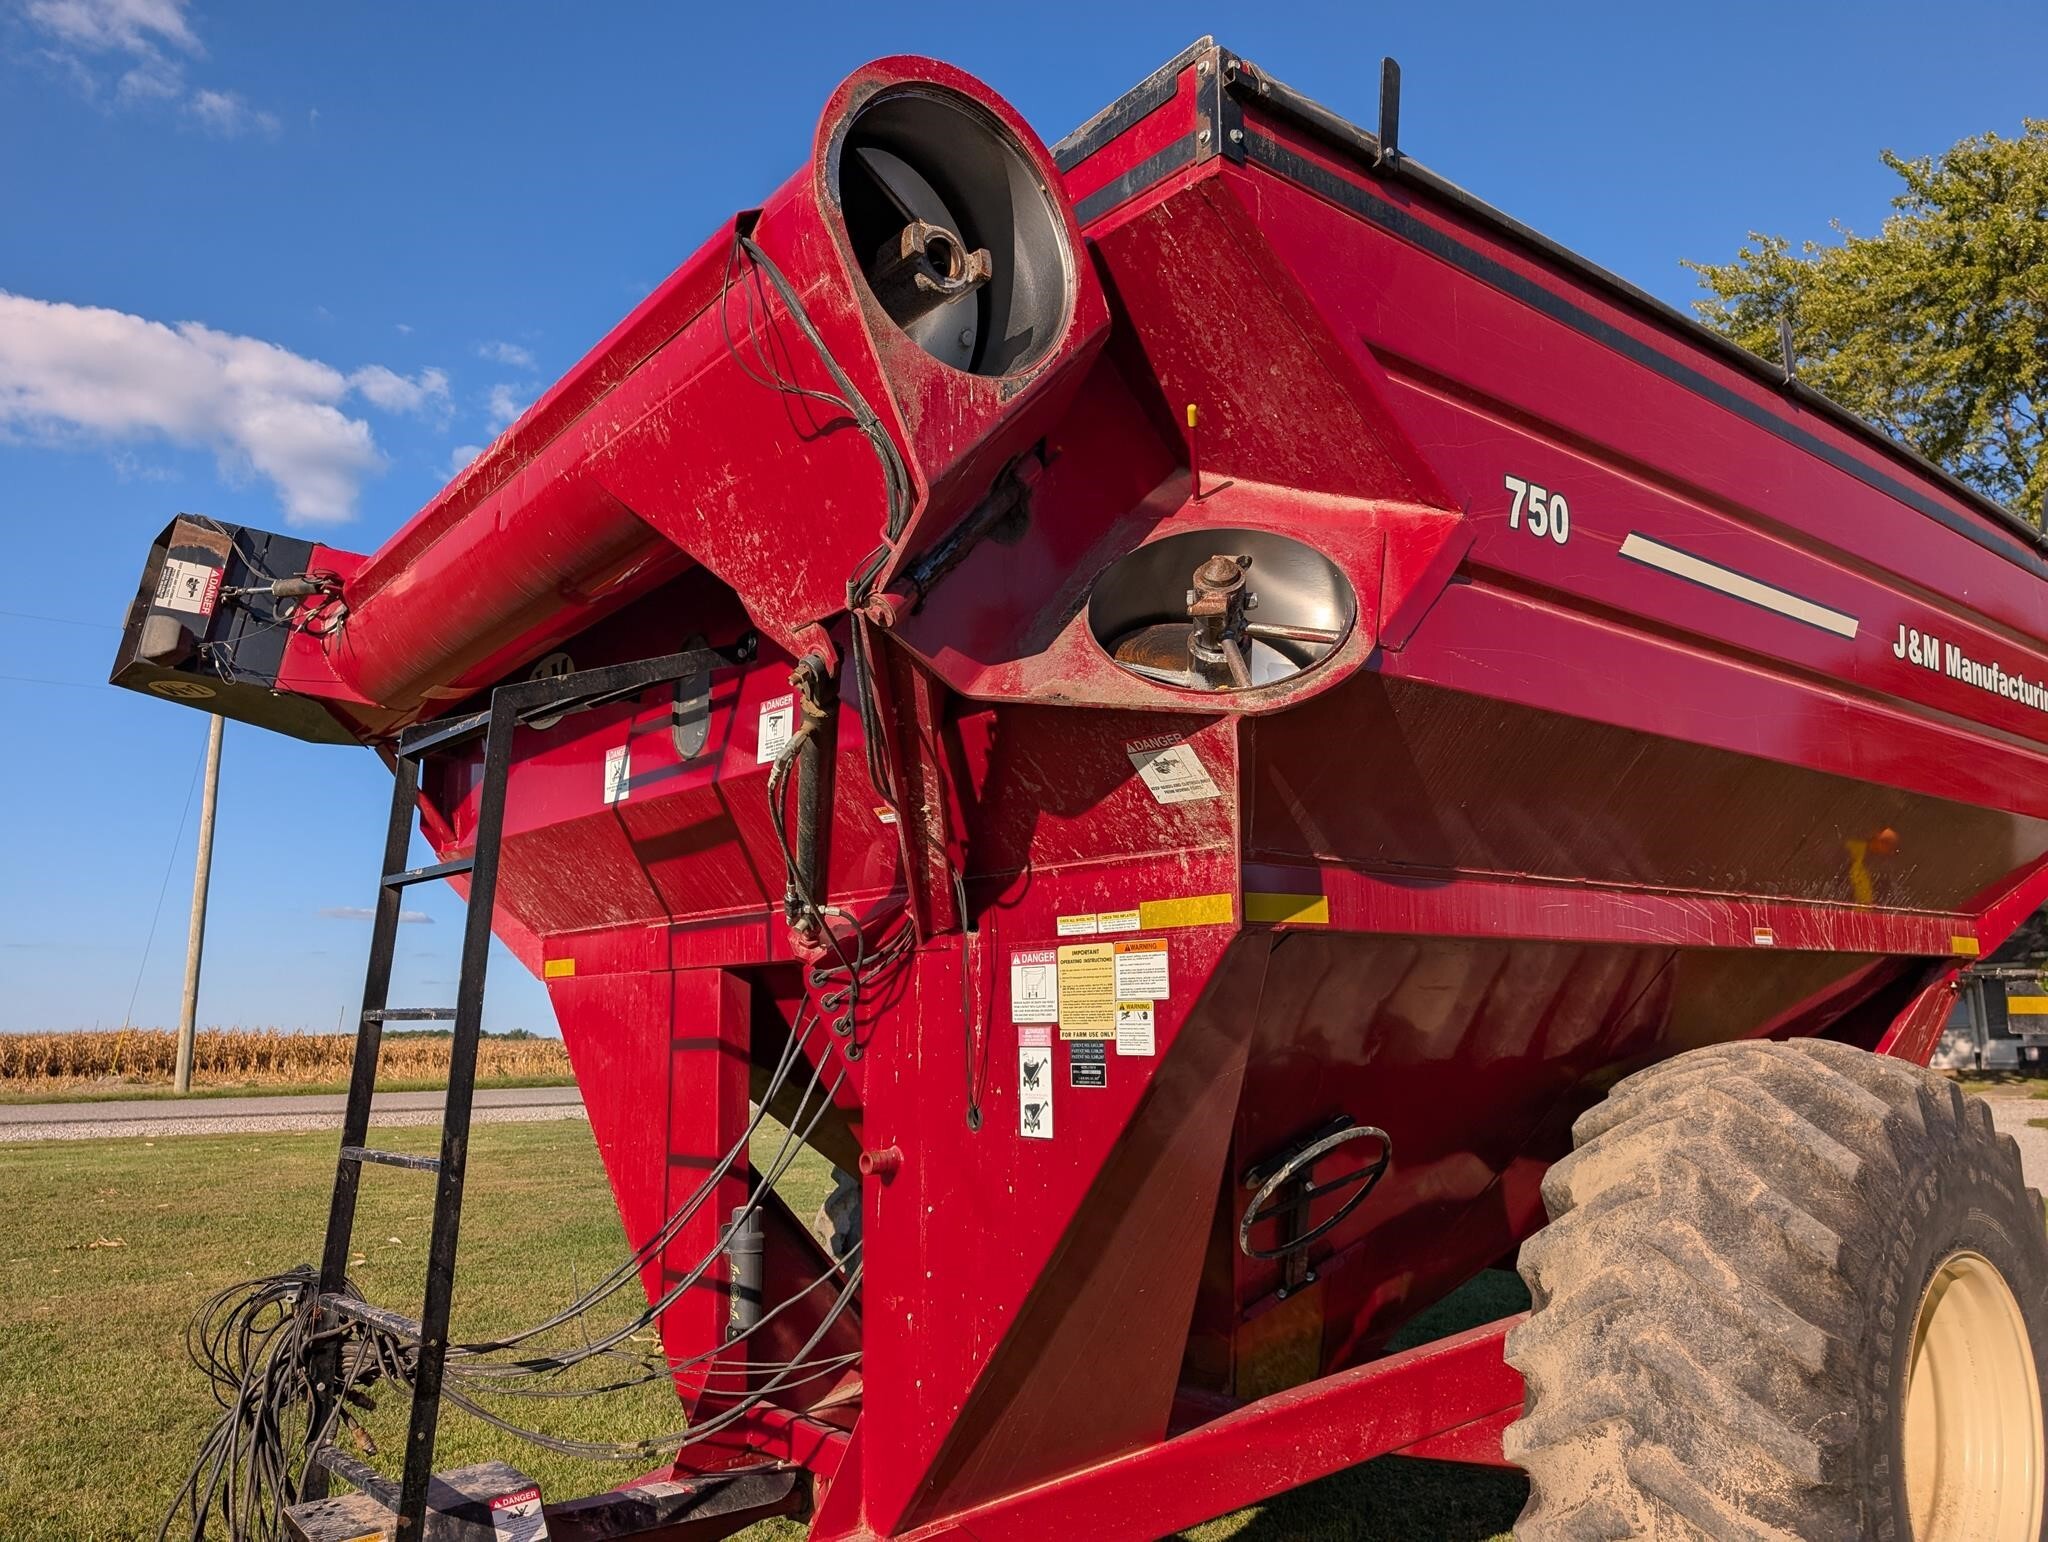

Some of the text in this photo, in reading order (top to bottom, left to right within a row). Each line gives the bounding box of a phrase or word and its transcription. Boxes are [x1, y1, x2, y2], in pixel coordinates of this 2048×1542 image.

[1505, 475, 1569, 544] 750
[201, 580, 219, 614] DANGER
[1893, 624, 1940, 671] J&M
[767, 696, 792, 710] DANGER
[1133, 733, 1183, 751] DANGER
[1130, 943, 1158, 951] WARNING
[1022, 951, 1056, 963] DANGER
[502, 1490, 537, 1506] DANGER
